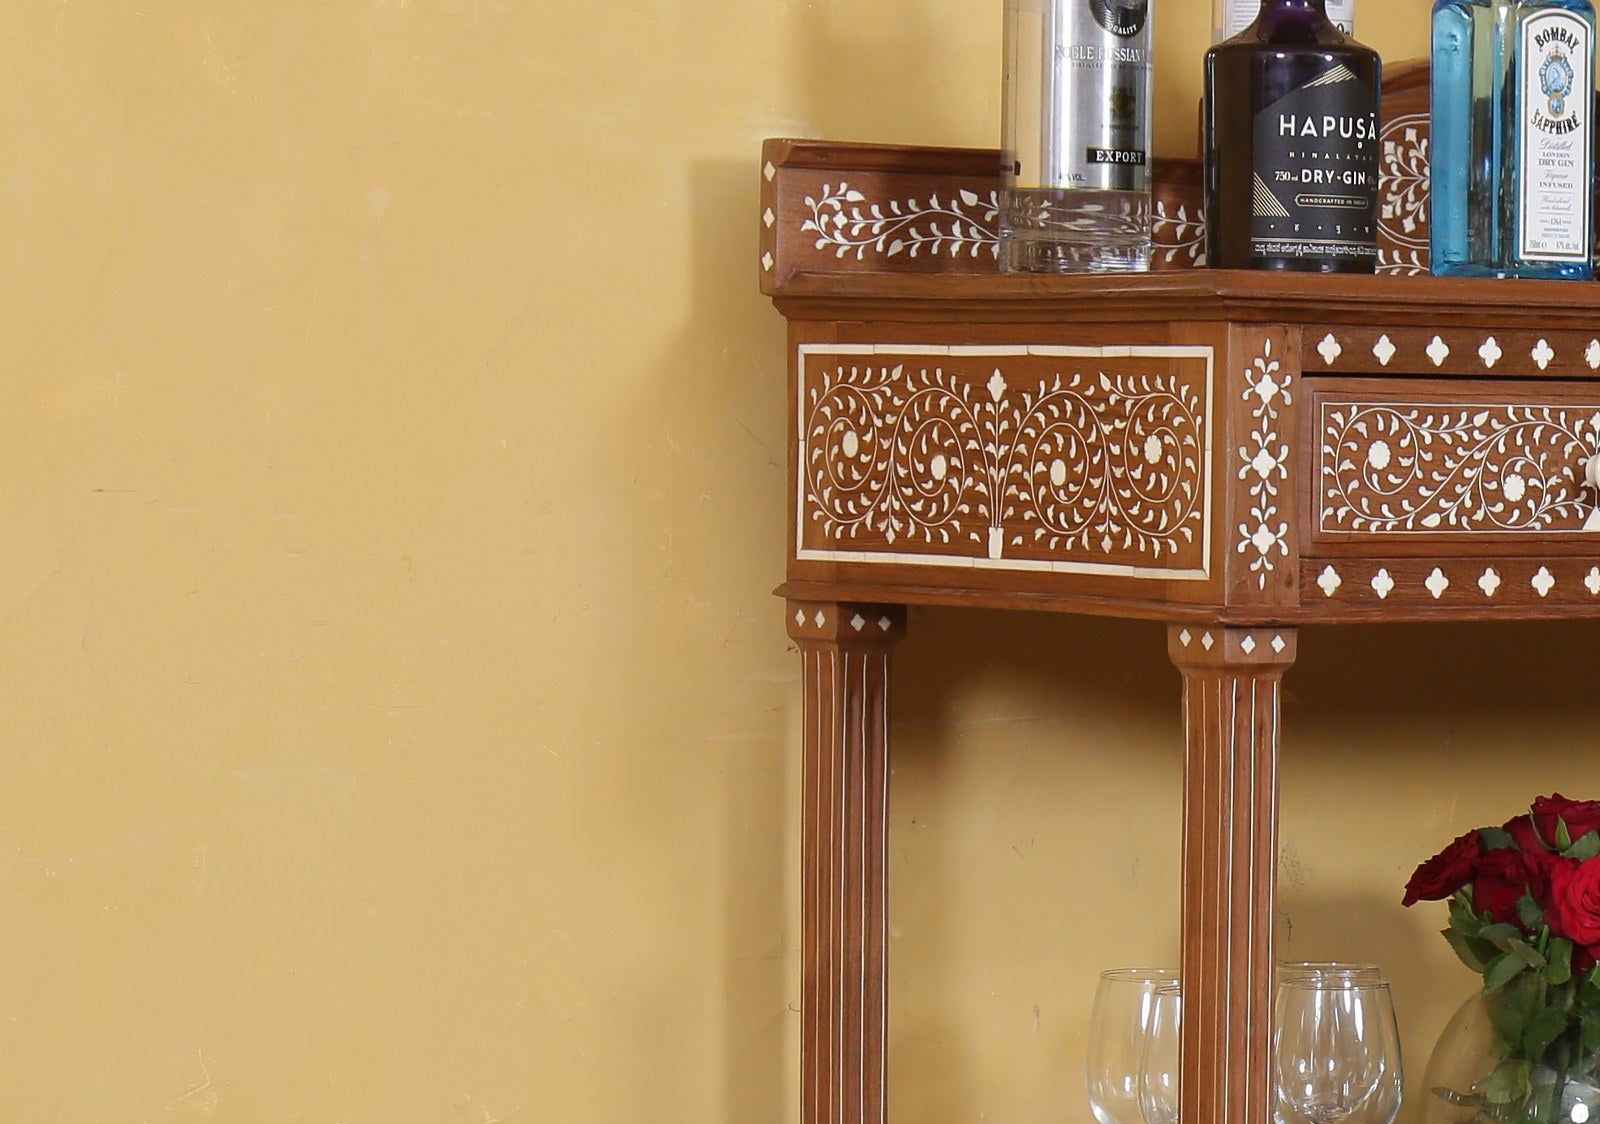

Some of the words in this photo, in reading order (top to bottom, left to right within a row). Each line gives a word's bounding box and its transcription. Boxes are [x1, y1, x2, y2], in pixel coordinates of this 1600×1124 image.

[1534, 26, 1580, 54] BOMBAY
[1531, 108, 1581, 135] SAPPHIRE
[1095, 149, 1142, 164] EXPORT
[1538, 158, 1556, 166] DRY
[1557, 159, 1574, 168] GIN
[1274, 170, 1291, 181] 750
[1539, 181, 1574, 189] INFUSED
[1300, 197, 1345, 205] HANDCRAFTED
